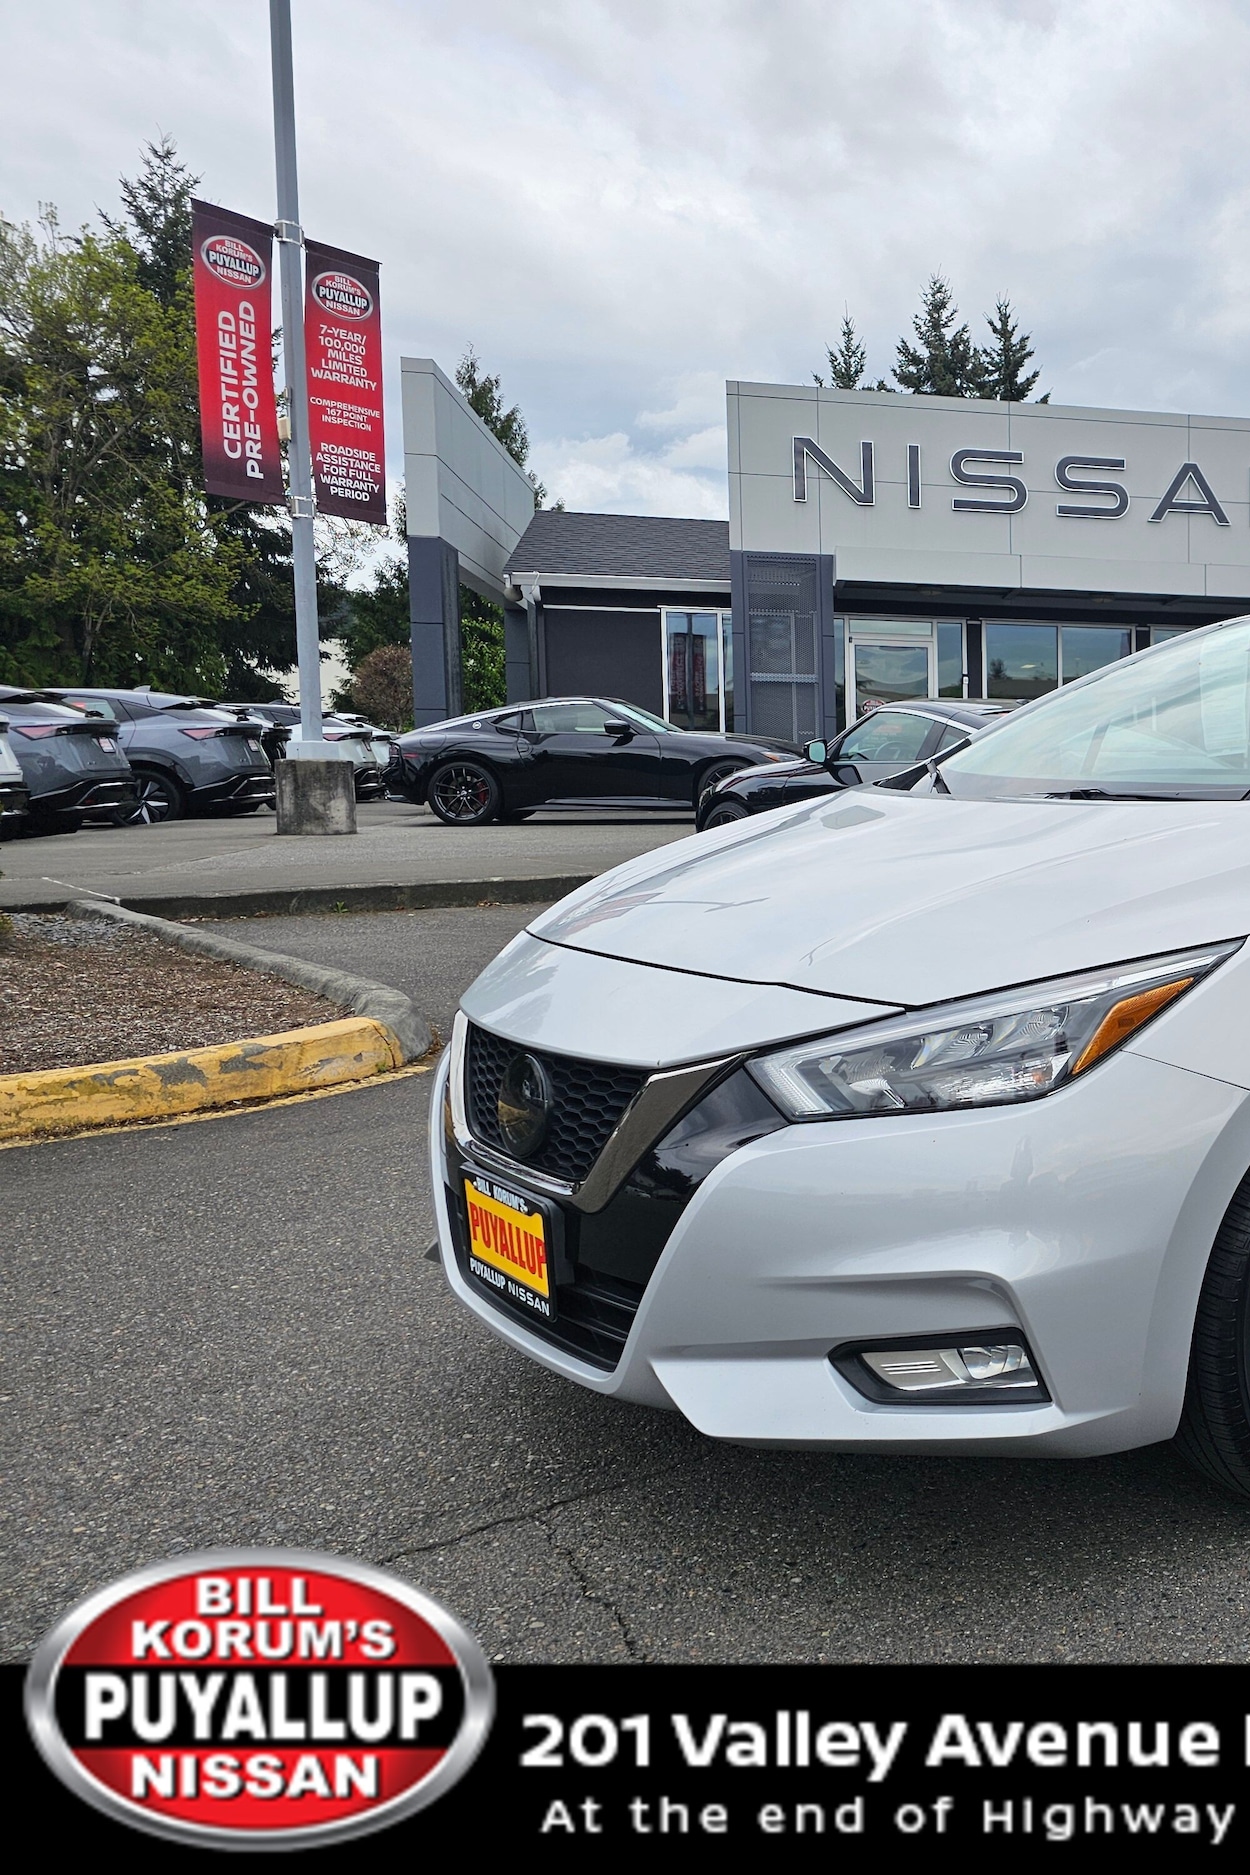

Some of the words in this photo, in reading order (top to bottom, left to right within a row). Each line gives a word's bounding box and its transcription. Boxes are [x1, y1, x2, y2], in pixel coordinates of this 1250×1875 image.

[216, 244, 252, 262] KORUM'S
[225, 240, 243, 252] BILL
[209, 250, 259, 276] PUYALLUP
[217, 266, 251, 284] NISSAN
[335, 275, 352, 286] BILL
[325, 280, 361, 295] KORUM'S
[319, 286, 367, 309] PUYALLUP
[325, 300, 360, 316] NISSAN
[319, 324, 366, 345] 7-YEAR/
[319, 336, 365, 355] 100,000
[327, 349, 362, 365] MILES
[321, 359, 367, 377] LIMITED
[218, 311, 241, 459] CERTIFIED
[311, 367, 377, 391] WARRANTY
[239, 301, 264, 479] PRE-OWNED
[310, 396, 380, 418] COMPREHENSIVE
[326, 408, 341, 417] 167
[343, 410, 367, 423] POINT
[322, 414, 371, 431] INSPECTION
[320, 442, 376, 462] ROADSIDE
[316, 452, 381, 473] ASSISTANCE
[323, 464, 347, 477] FOR
[348, 469, 374, 482] FULL
[320, 473, 380, 493] WARRANTY
[330, 486, 370, 502] PERIOD
[469, 1201, 547, 1279] PUYALLUP
[470, 1258, 506, 1289] PUYALLUP
[508, 1281, 550, 1316] NISSAN
